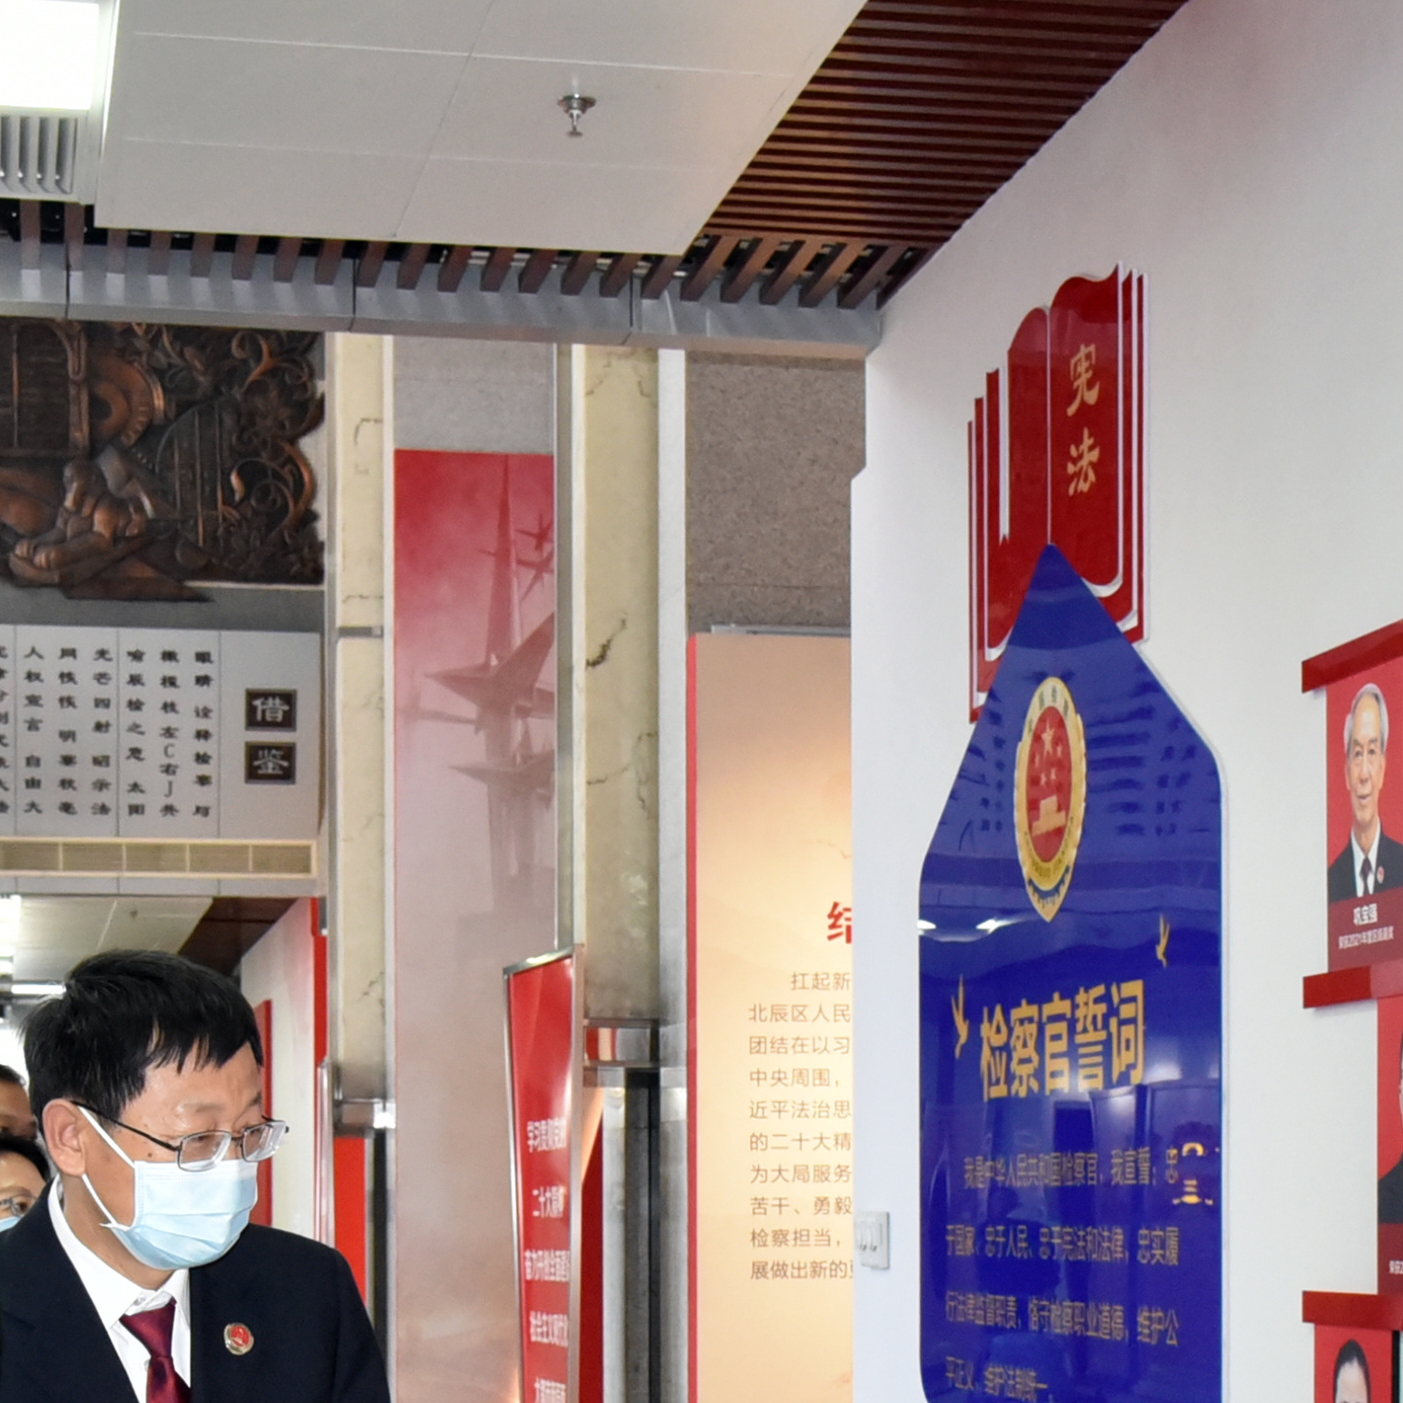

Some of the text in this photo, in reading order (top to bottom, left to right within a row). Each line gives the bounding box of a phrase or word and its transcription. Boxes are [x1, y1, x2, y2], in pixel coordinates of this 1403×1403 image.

[1066, 344, 1101, 497] 宪法
[791, 971, 851, 991] 扛起新
[749, 1003, 851, 1023] 北辰区人民
[749, 1036, 851, 1055] 团结在以习
[979, 978, 1145, 1102] 检察官誓词
[749, 1099, 852, 1120] 近平法治思
[750, 1132, 852, 1152] 的二十大精
[750, 1164, 852, 1185] 为大局服务
[750, 1195, 853, 1217] 苦干、勇毅
[751, 1260, 853, 1281] 展做出新的
